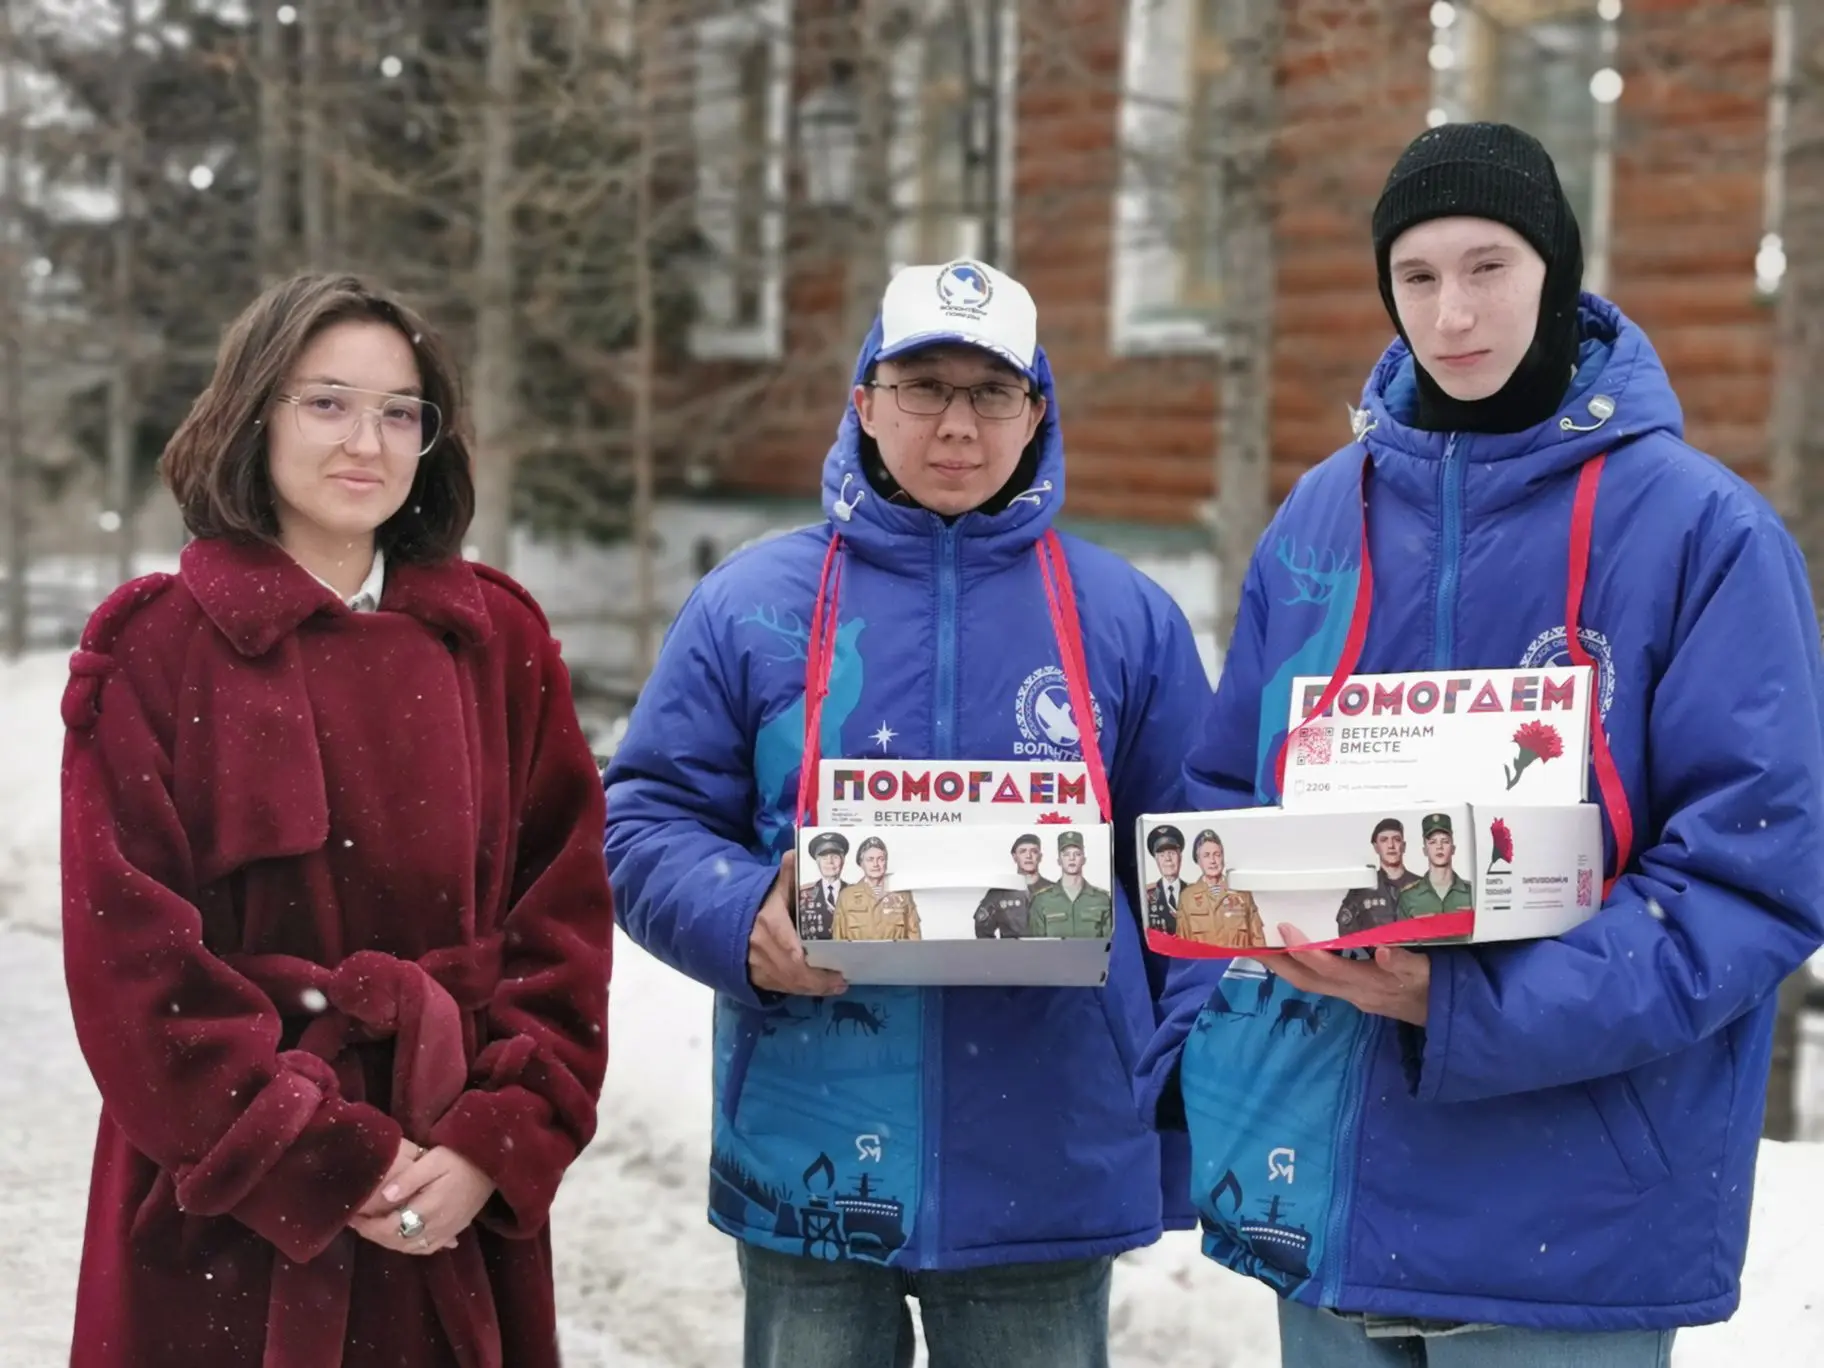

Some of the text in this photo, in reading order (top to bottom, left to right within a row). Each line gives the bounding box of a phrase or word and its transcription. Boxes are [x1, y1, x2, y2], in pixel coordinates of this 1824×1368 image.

[1301, 674, 1575, 718] ПОМОГАЕМ
[1340, 726, 1435, 740] ВЕТЕРАНАМ
[1339, 741, 1401, 754] ВМЕСТЕ
[833, 770, 1086, 804] ПОМОГАЕМ
[1306, 782, 1331, 792] 2206
[874, 811, 962, 823] ВЕТЕРАНАМ
